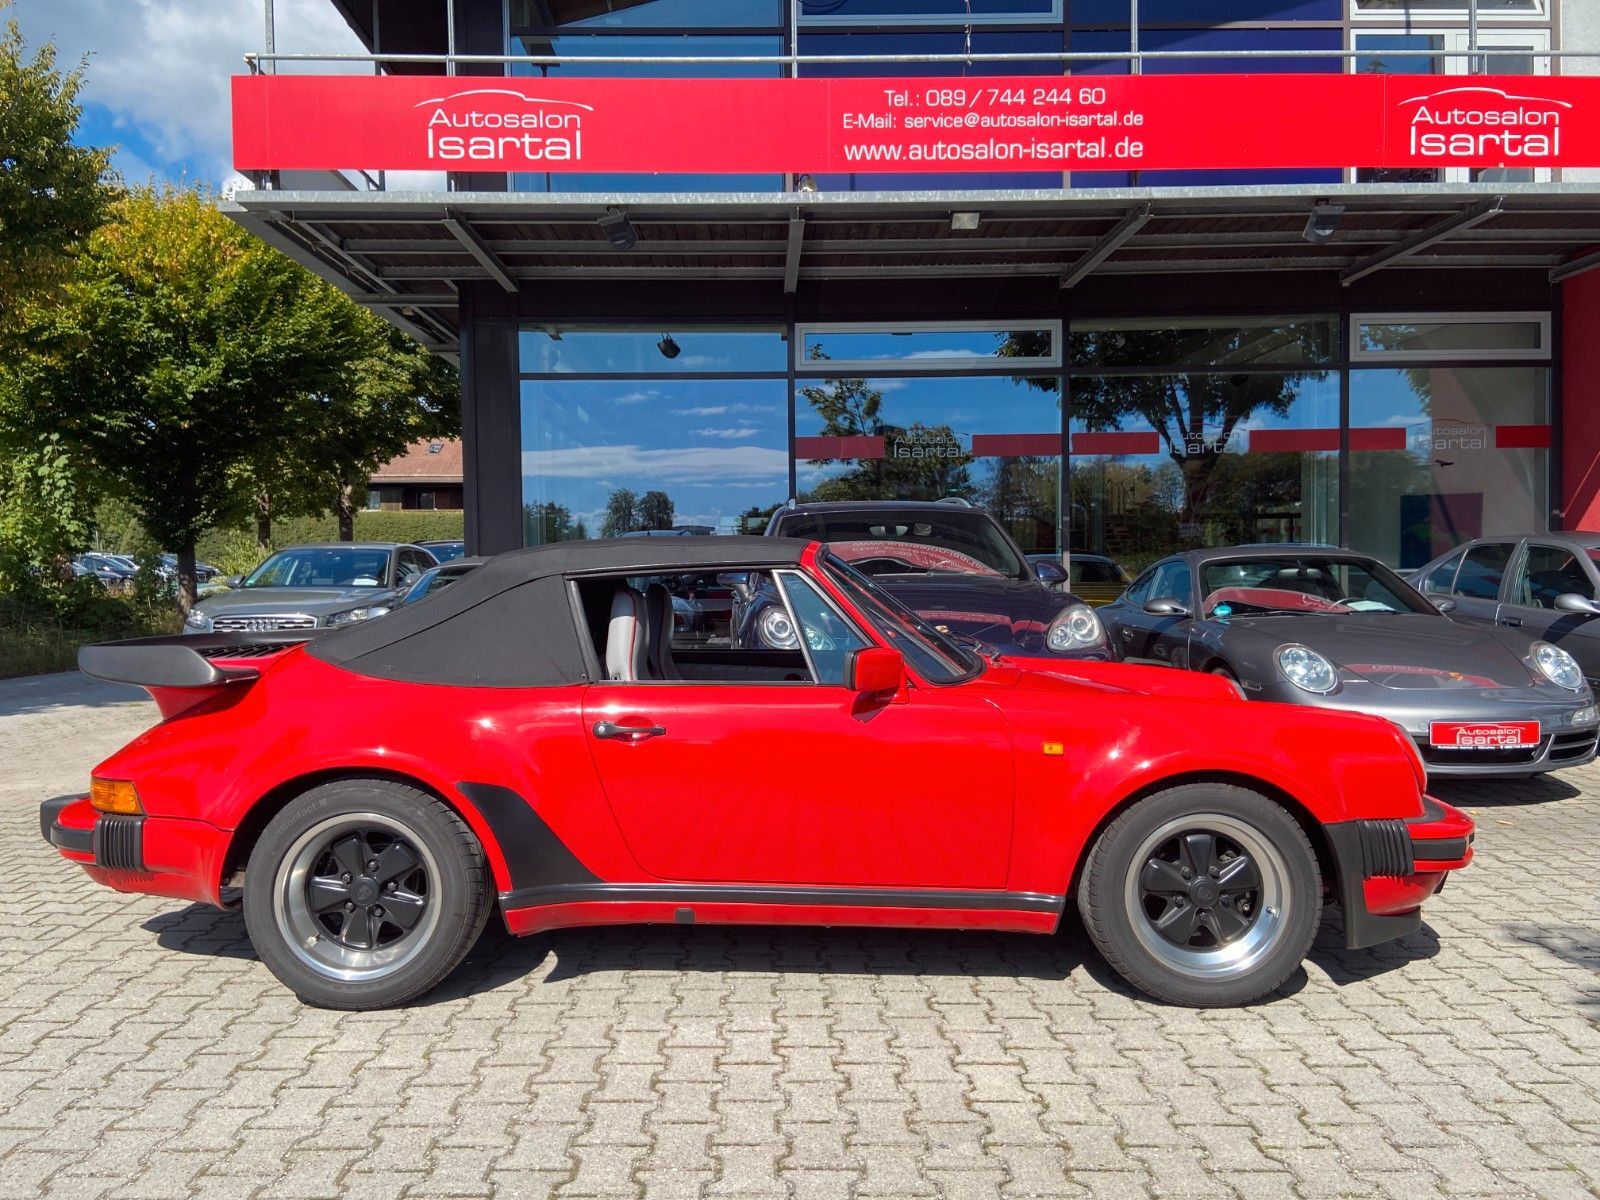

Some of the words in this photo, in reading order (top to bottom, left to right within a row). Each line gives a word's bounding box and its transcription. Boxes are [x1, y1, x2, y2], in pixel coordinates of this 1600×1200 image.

[883, 90, 920, 107] Tel.:
[925, 89, 966, 107] 089
[986, 89, 1026, 106] 744
[1032, 88, 1072, 105] 244
[1078, 87, 1106, 105] 60
[428, 108, 581, 129] Autosalon
[842, 113, 897, 129] E-Mail:
[904, 111, 1144, 129] service@autosalon-isartal.de
[1410, 105, 1560, 125] Autosalon
[427, 128, 581, 161] Isartal
[844, 136, 1144, 161] www.autosalon-isartal.de
[1410, 125, 1560, 156] Isartal
[894, 435, 963, 445] Autosalo
[1456, 730, 1521, 745] Isartal
